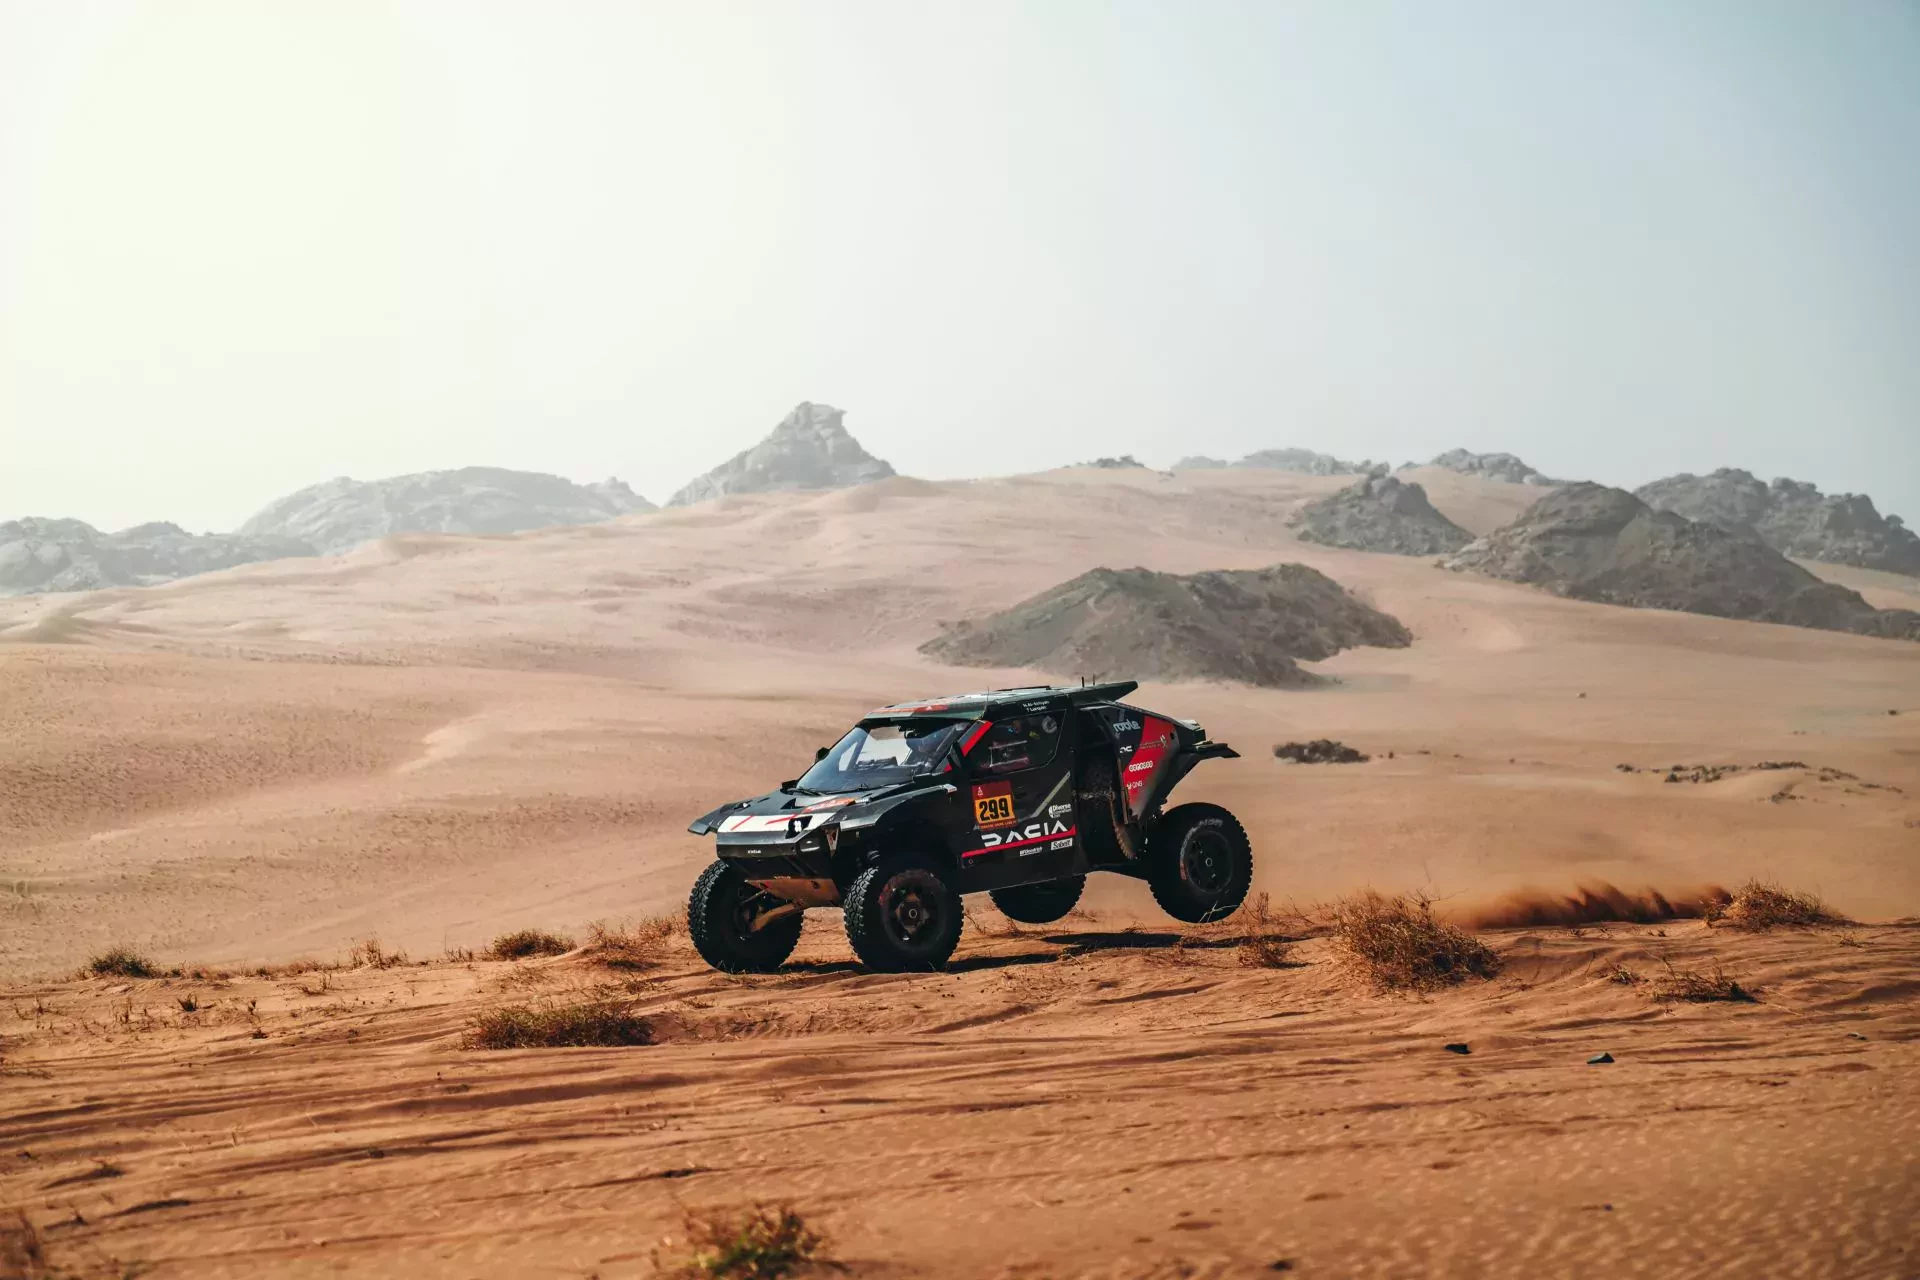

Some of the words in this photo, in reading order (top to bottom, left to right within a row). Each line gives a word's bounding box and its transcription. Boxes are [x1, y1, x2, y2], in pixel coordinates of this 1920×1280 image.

[979, 797, 1010, 821] 299
[981, 820, 1068, 847] DACIA
[1052, 839, 1071, 849] Sabelt
